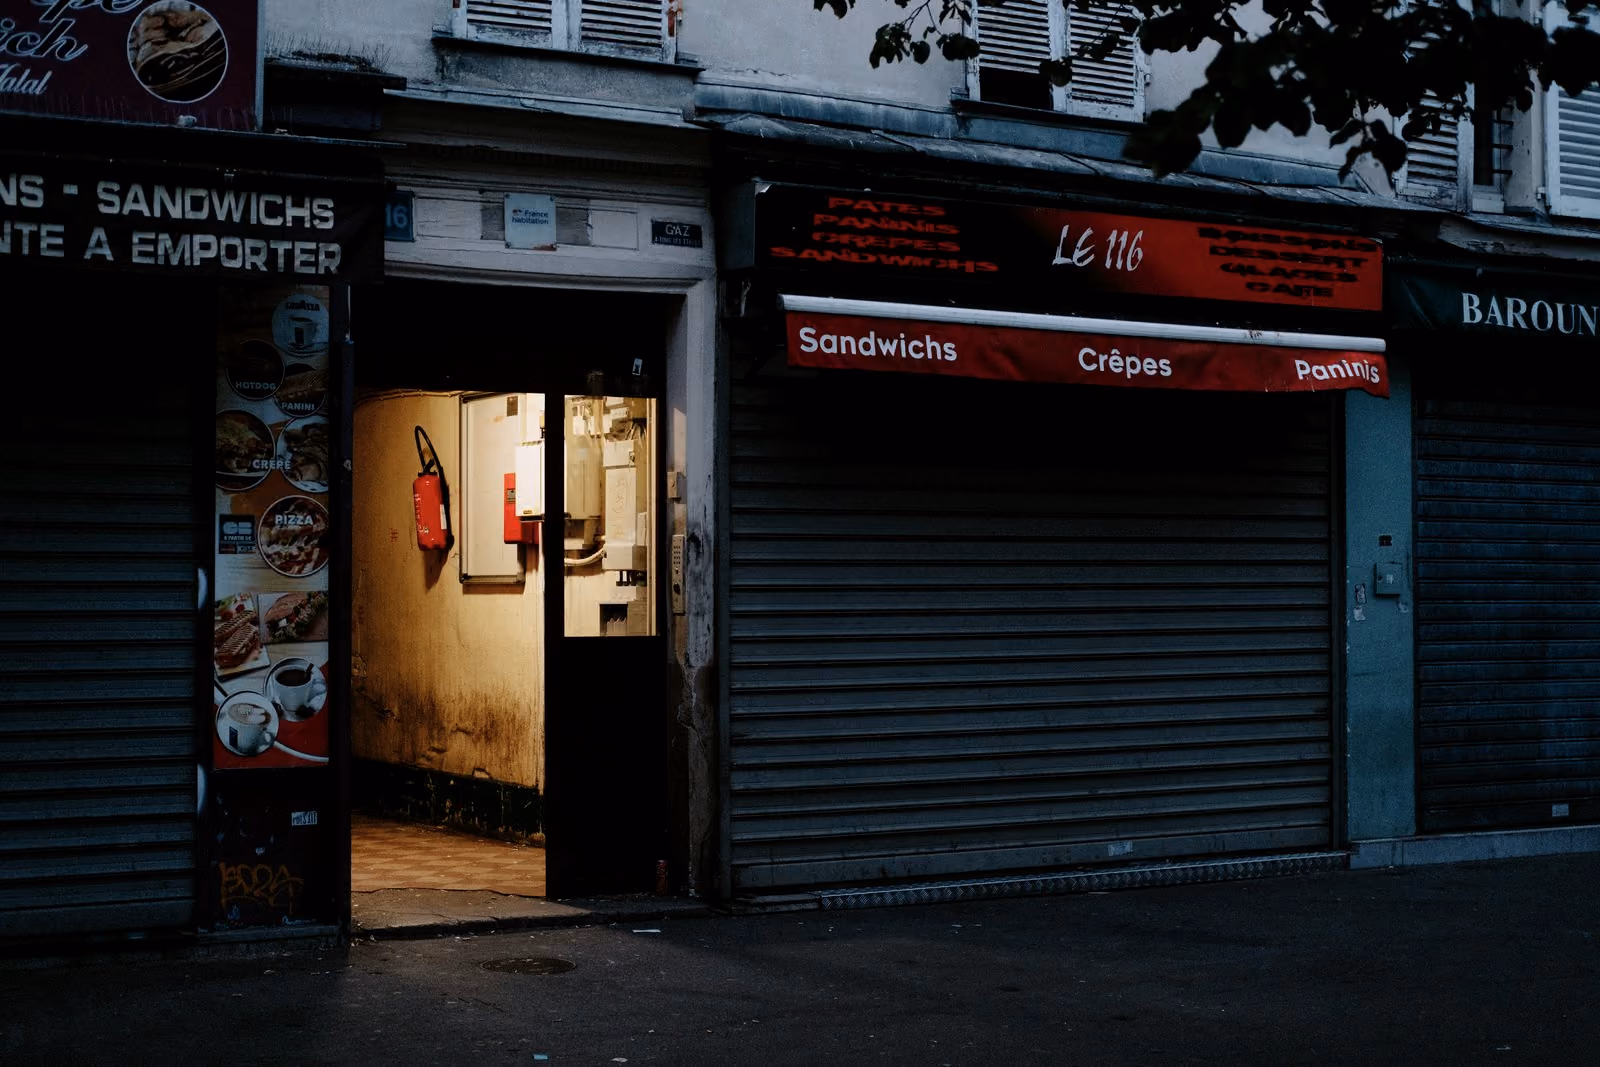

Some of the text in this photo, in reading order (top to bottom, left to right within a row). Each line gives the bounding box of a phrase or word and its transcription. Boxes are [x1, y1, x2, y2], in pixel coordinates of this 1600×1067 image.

[97, 180, 335, 230] SANDWICHS
[828, 196, 946, 217] PATES
[665, 223, 691, 237] GAZ
[813, 213, 961, 235] PANINIS
[82, 225, 115, 262] A
[131, 230, 342, 275] EMPORTER
[769, 246, 1000, 274] SANDWICHS
[1051, 224, 1145, 272] LE 116
[799, 326, 958, 362] Sandwichs
[1078, 347, 1173, 379] Crêpes
[1294, 358, 1381, 385] Paninis
[281, 401, 316, 411] PANINI
[274, 513, 314, 527] PIZZA
